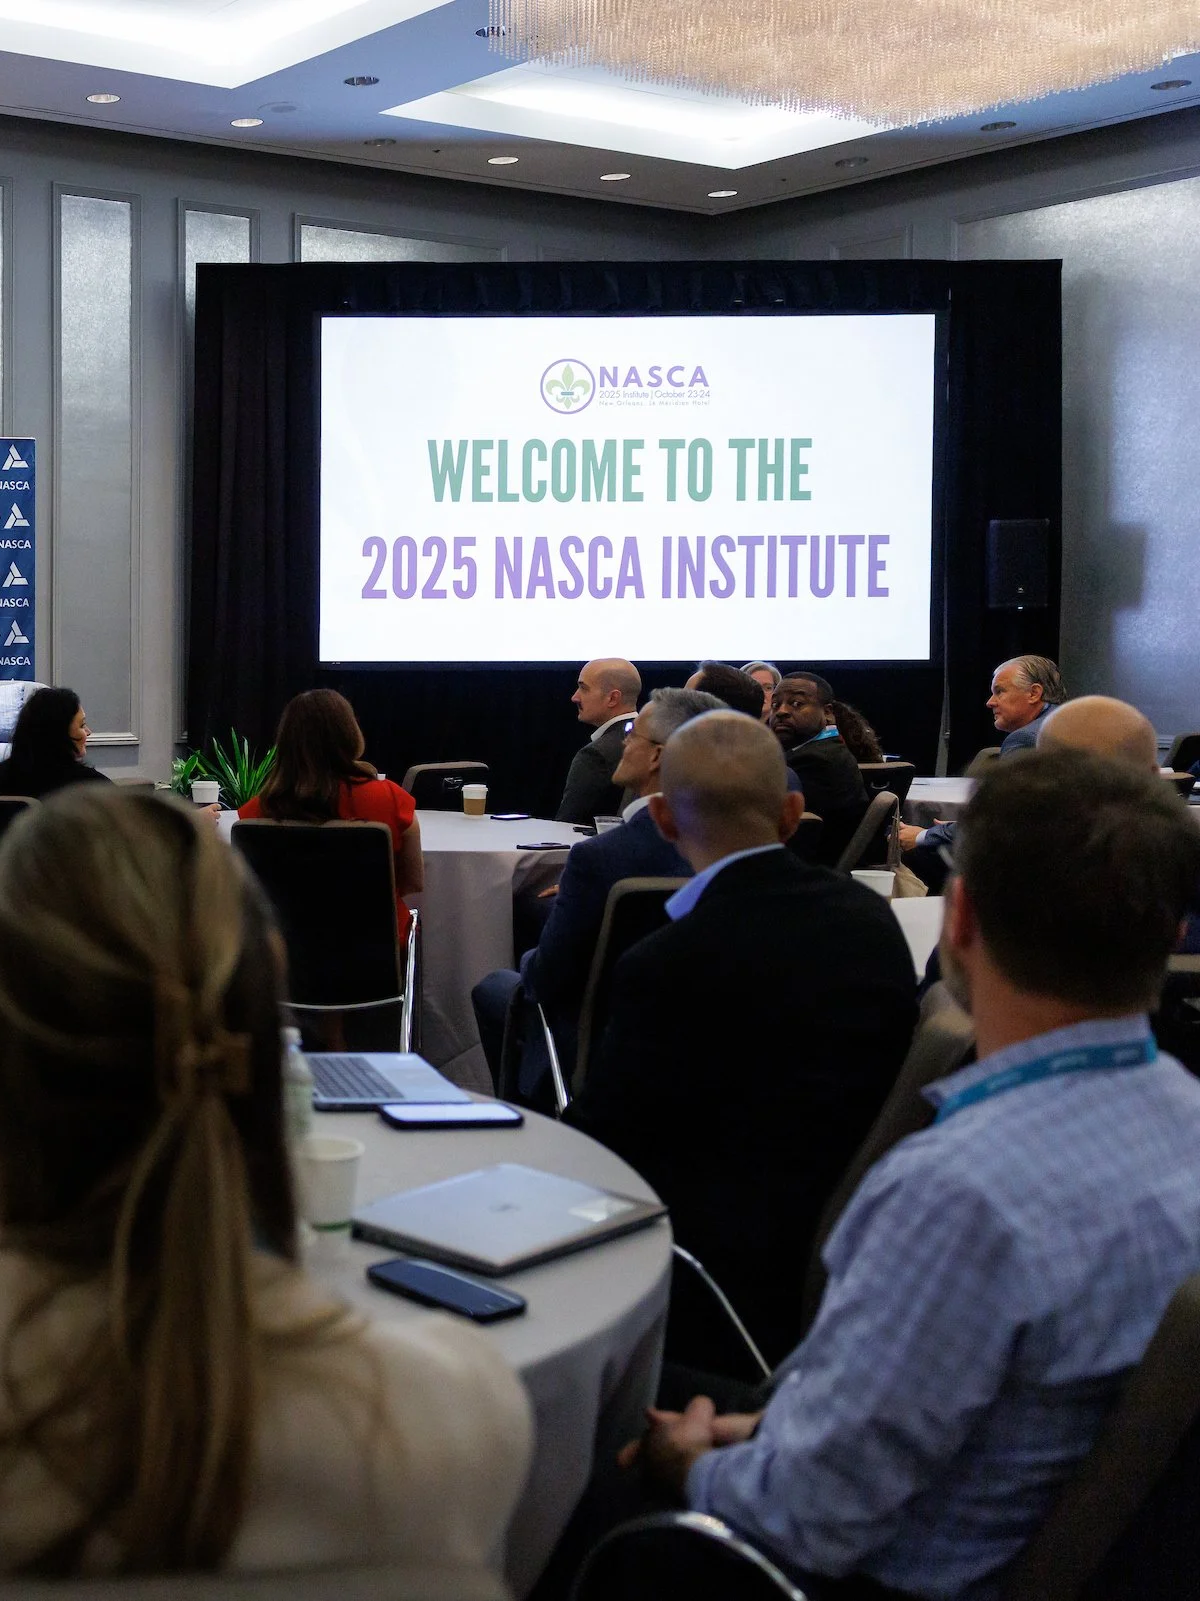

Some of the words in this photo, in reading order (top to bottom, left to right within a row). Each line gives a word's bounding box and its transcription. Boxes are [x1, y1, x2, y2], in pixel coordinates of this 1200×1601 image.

[599, 365, 710, 388] NASCA
[599, 390, 621, 399] 2025
[623, 389, 649, 399] Institute
[654, 389, 685, 399] October
[427, 438, 645, 503] WELCOME
[658, 438, 714, 502] TO
[728, 438, 813, 501] THE
[361, 535, 477, 600] 2025
[494, 535, 645, 600] NASCA
[661, 534, 890, 599] INSTITUTE
